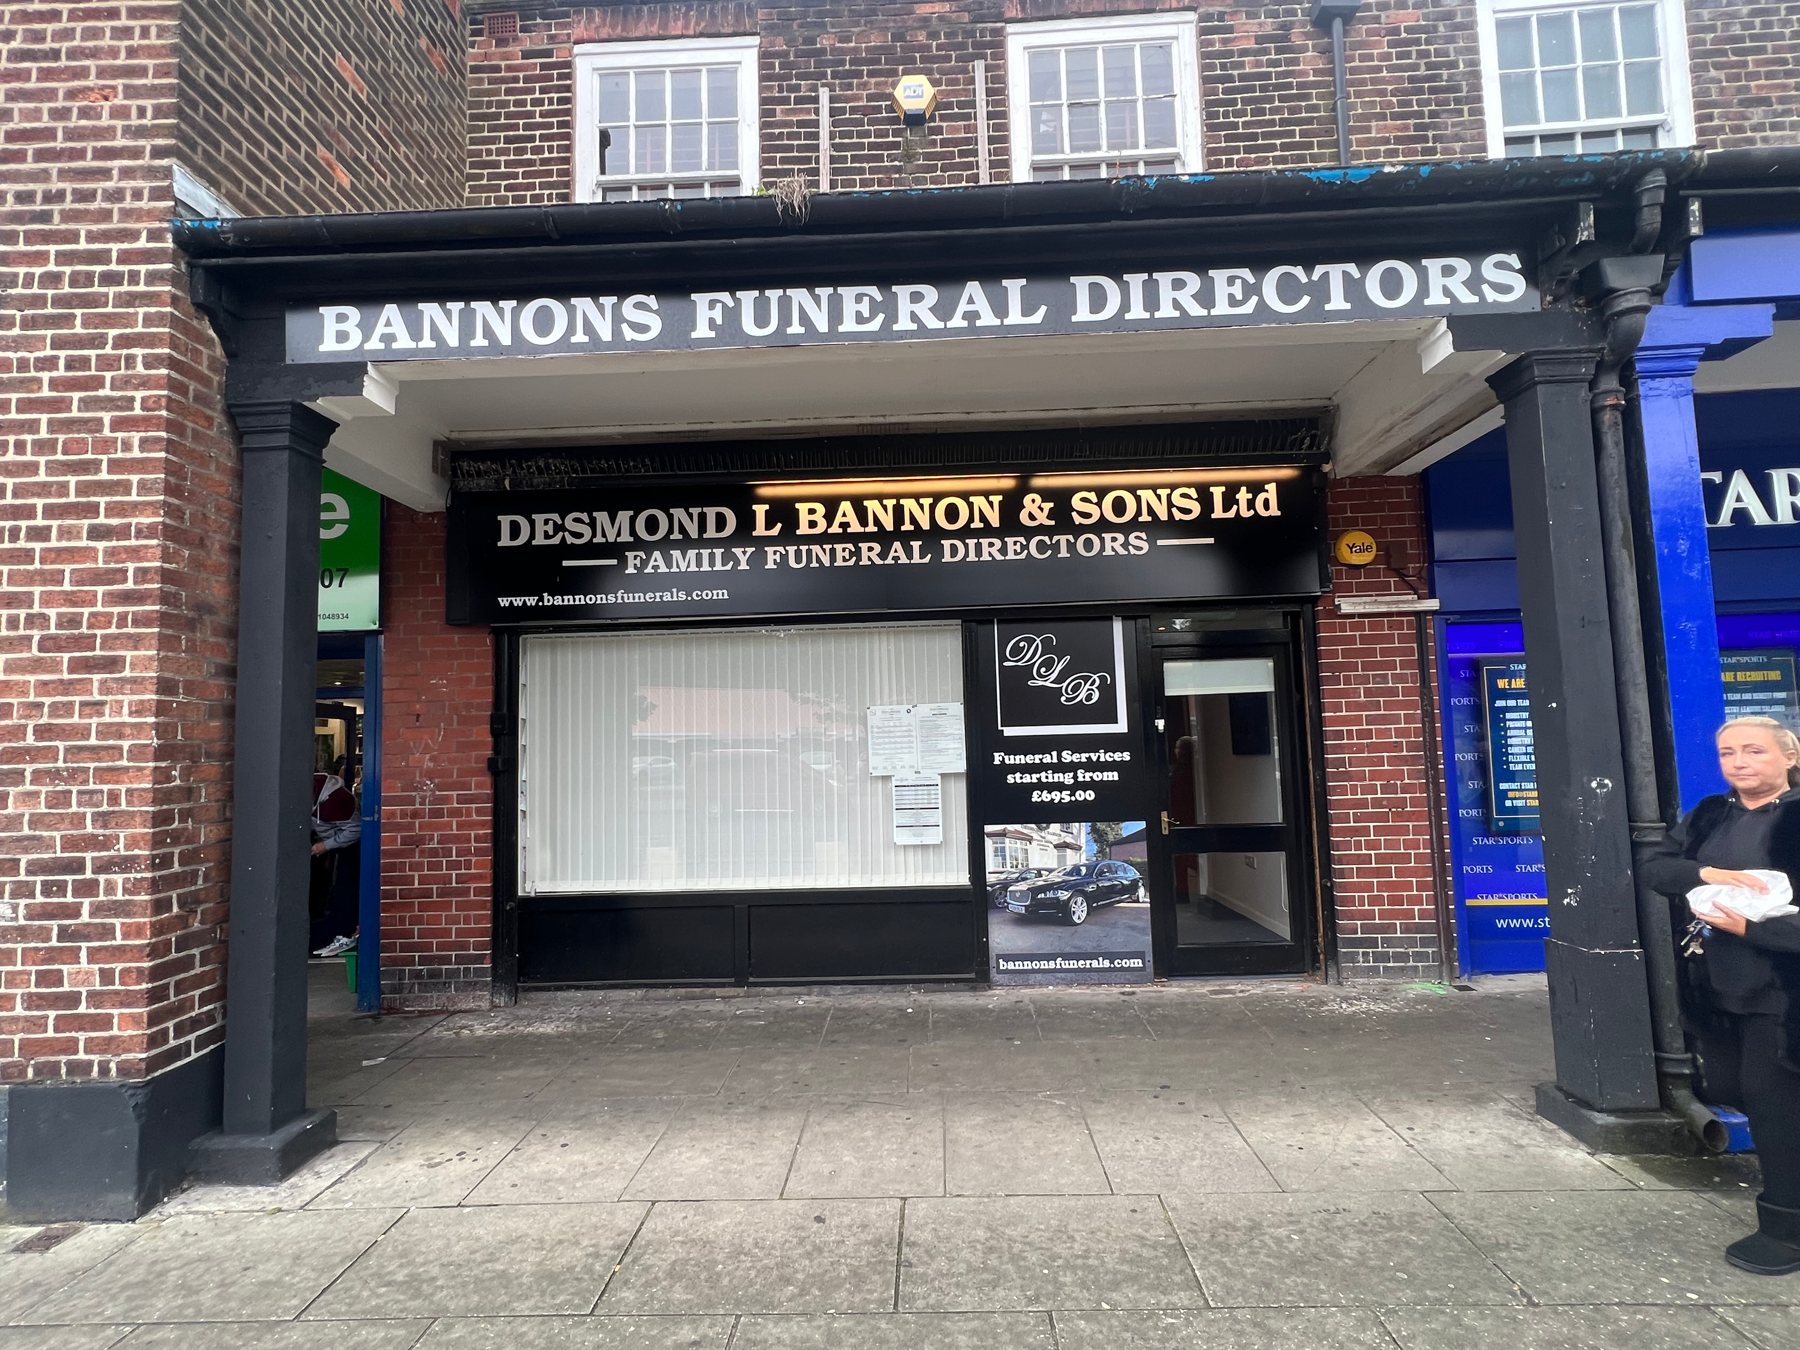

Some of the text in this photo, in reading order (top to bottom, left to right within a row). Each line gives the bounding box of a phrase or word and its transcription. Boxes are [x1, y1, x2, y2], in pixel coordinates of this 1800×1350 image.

[318, 253, 1527, 353] BANNONS FUNERAL DIRECTORS
[497, 481, 1281, 547] DESMOND L BANNON & SONS Ltd
[625, 531, 1149, 575] FAMILY FUNERAL DIRECTORS
[1346, 542, 1373, 554] Yale
[320, 568, 349, 589] 07
[498, 586, 729, 607] www.bannonsfunerals.com
[1497, 678, 1526, 688] WE ARE
[1737, 671, 1781, 681] RECRUITING
[993, 750, 1131, 765] Funeral Services
[1007, 769, 1119, 784] starting from
[1031, 789, 1096, 804] £695.00
[1463, 865, 1493, 873] PORTS
[1496, 916, 1551, 928] www.st
[999, 957, 1143, 971] bannonsfunerals.com
